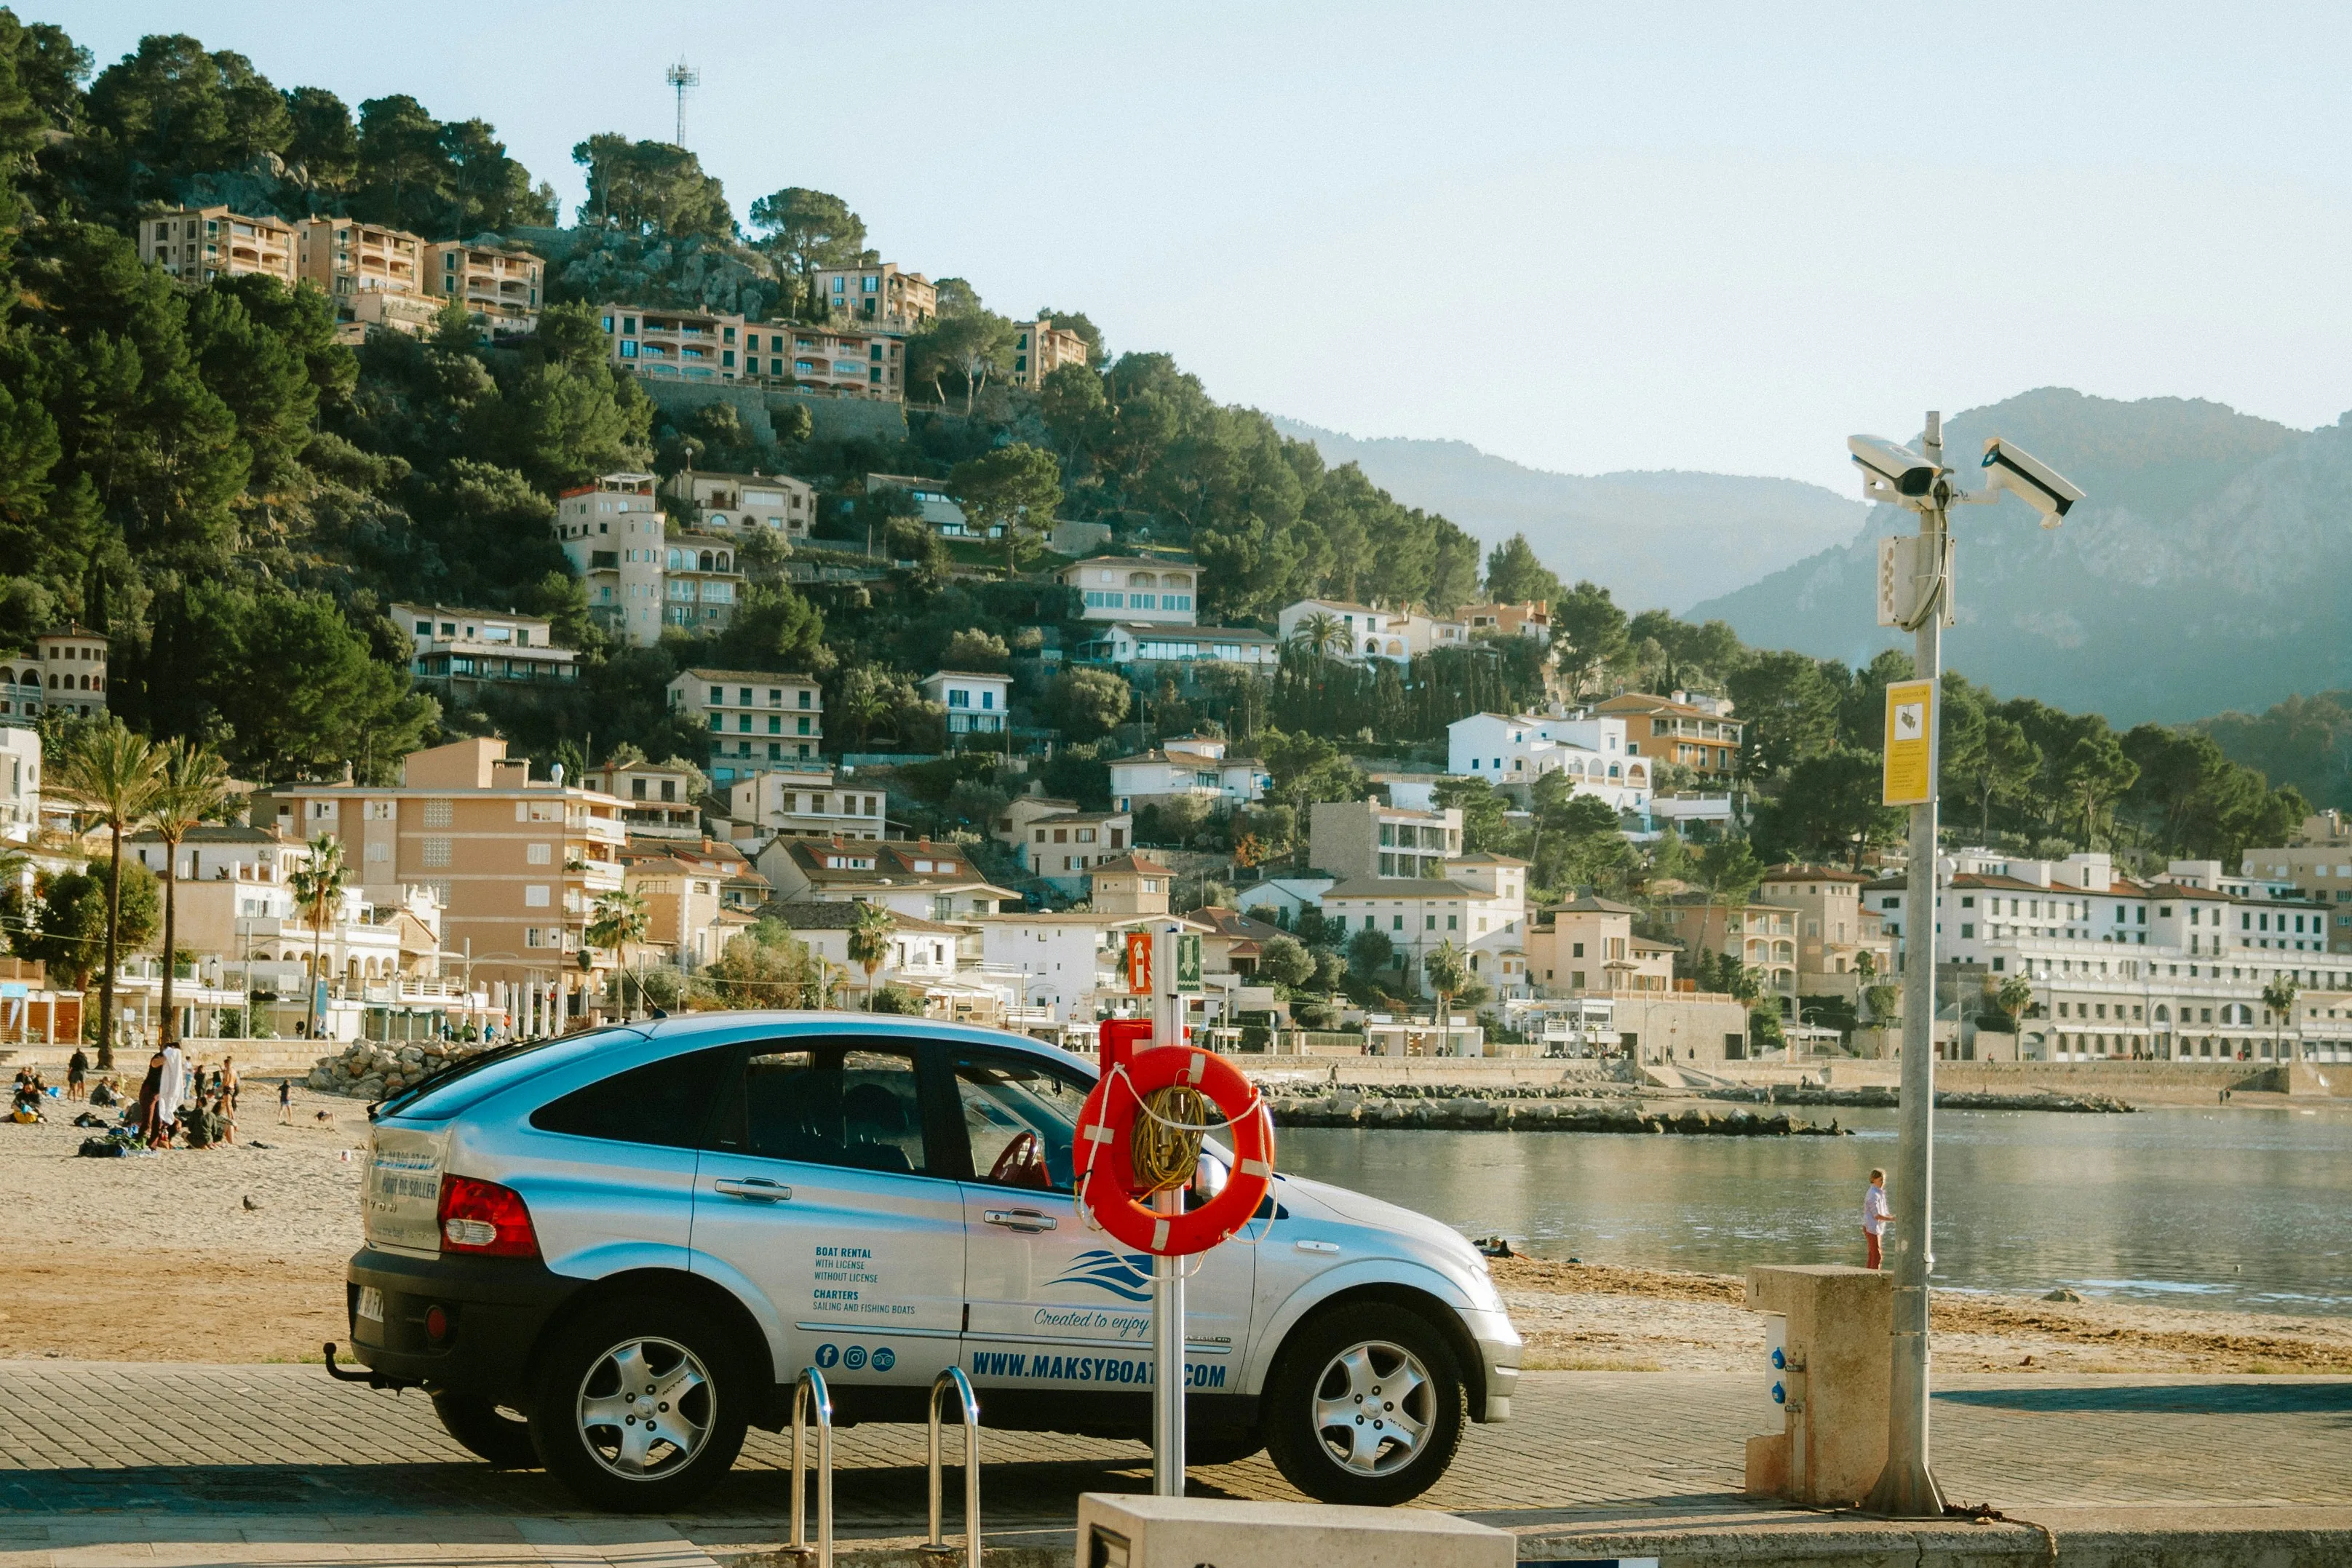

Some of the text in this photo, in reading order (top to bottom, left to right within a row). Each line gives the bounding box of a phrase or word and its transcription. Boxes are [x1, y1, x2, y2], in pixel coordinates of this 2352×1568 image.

[409, 1180, 437, 1200] SOLLER
[816, 1246, 872, 1258] BOAT RENTAL
[815, 1259, 865, 1270] WITH LICENSE
[814, 1272, 878, 1283] WITHOUT LICENSE
[814, 1289, 859, 1300] CHARTERS
[813, 1302, 915, 1315] SAILING AND FISHING BOATS
[1034, 1308, 1149, 1337] Created to enjoy
